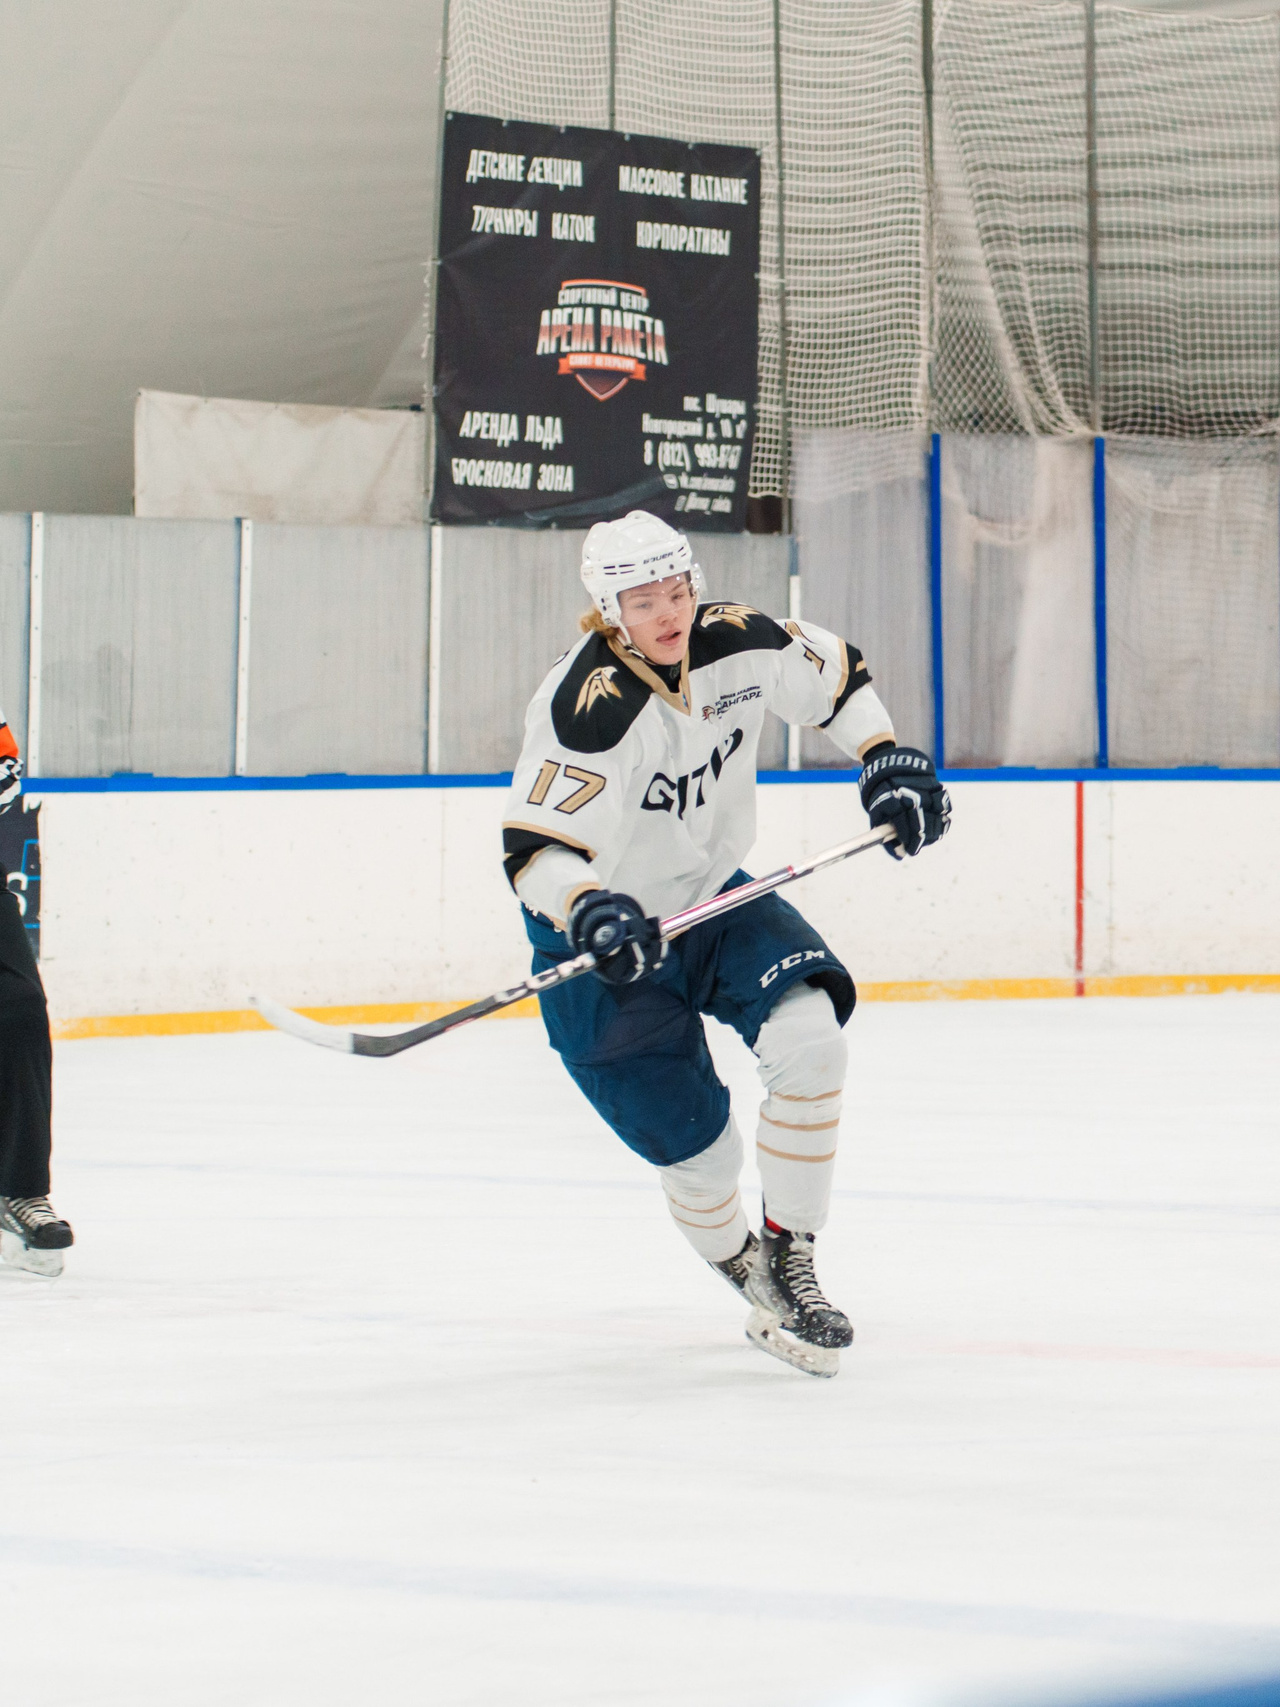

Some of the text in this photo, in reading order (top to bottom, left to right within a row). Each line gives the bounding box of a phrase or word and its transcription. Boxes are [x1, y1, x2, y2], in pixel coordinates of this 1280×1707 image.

[465, 149, 583, 191] ДЕТСКИЕ СЕКЦИИ
[619, 165, 748, 205] МАССОВОЕ КАТАНИЕ
[471, 205, 596, 243] ТУРНИРЫ КАТОК
[636, 220, 731, 256] КОРПОРАТИВЫ
[536, 307, 669, 366] АРЕНА РАКЕТА
[459, 411, 564, 451] АРЕНДА ЛЬДА
[451, 457, 575, 492] БРОСКОВАЯ ЗОНА
[644, 439, 654, 466] 8
[658, 440, 692, 472] (812)
[527, 759, 607, 815] 17
[758, 950, 825, 989] CCM
